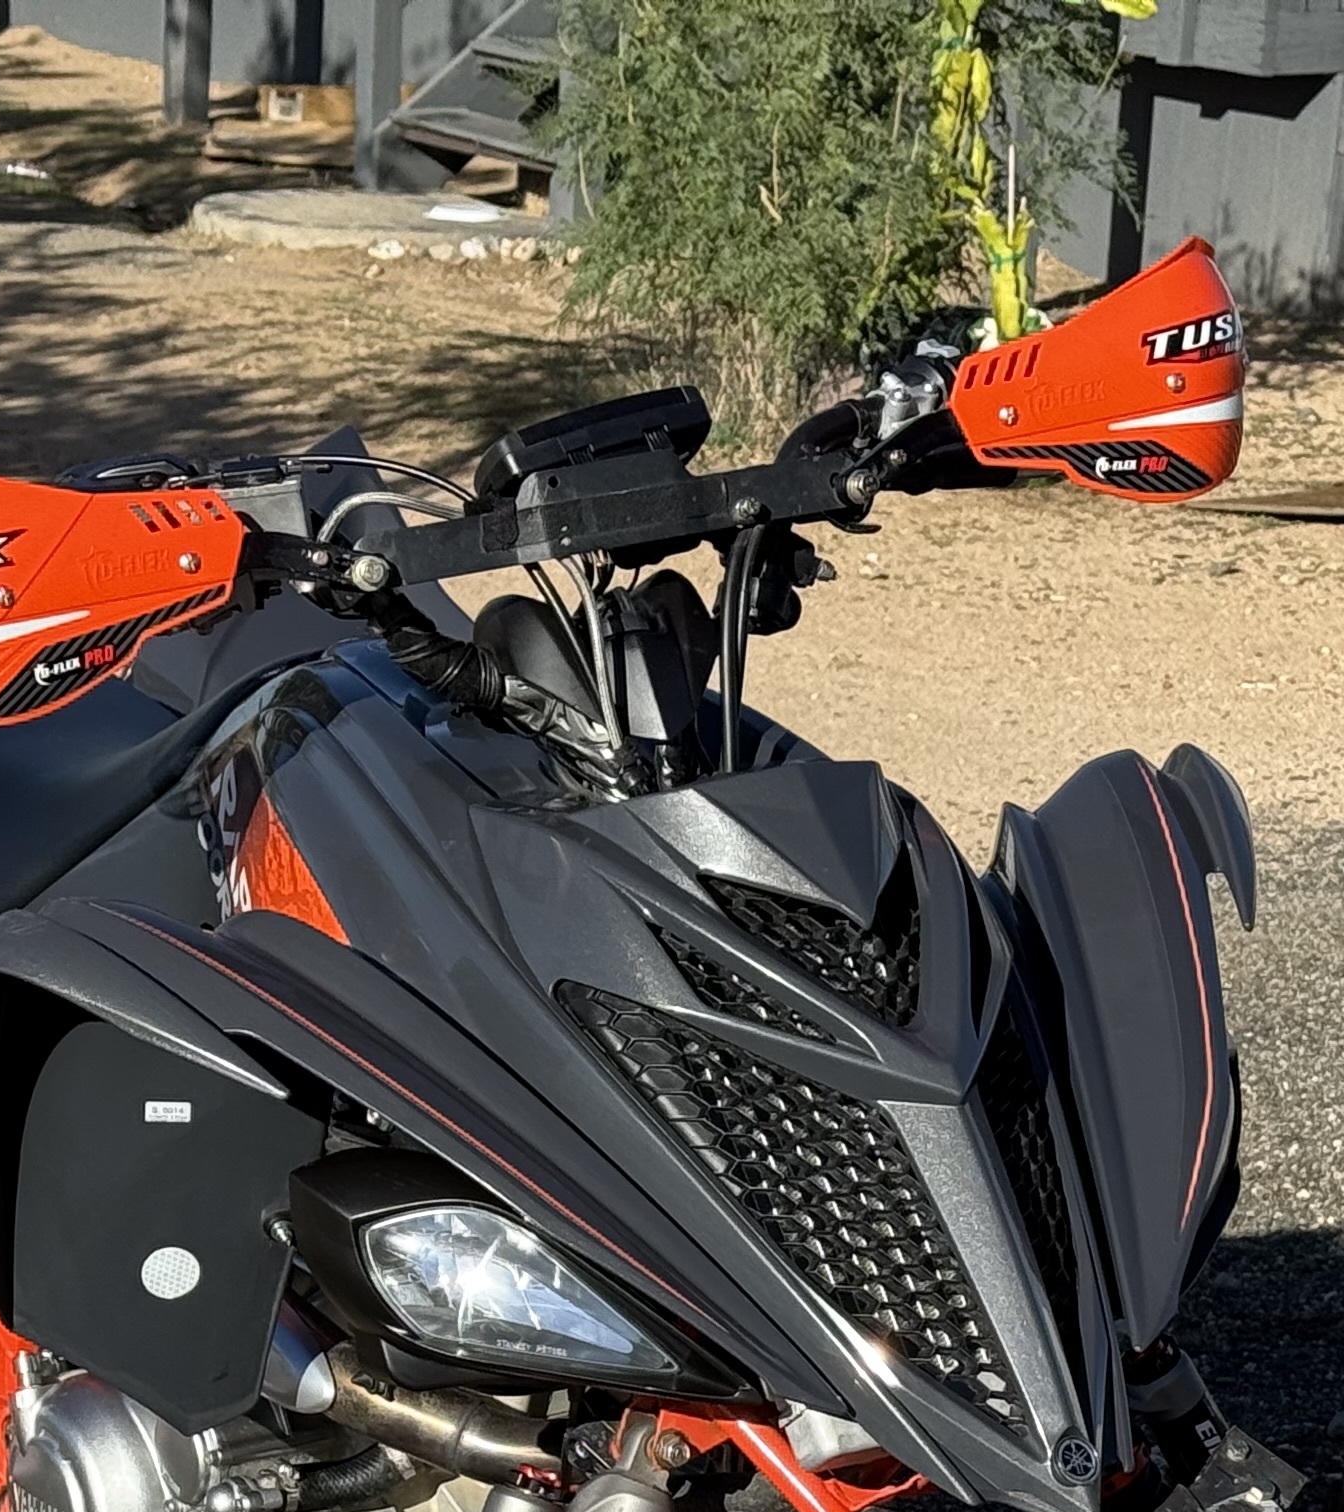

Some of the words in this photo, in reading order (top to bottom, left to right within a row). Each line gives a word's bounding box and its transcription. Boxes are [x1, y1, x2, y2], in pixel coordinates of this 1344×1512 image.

[1147, 314, 1233, 359] TUS
[1139, 456, 1169, 474] PRO
[84, 644, 114, 670] PRO
